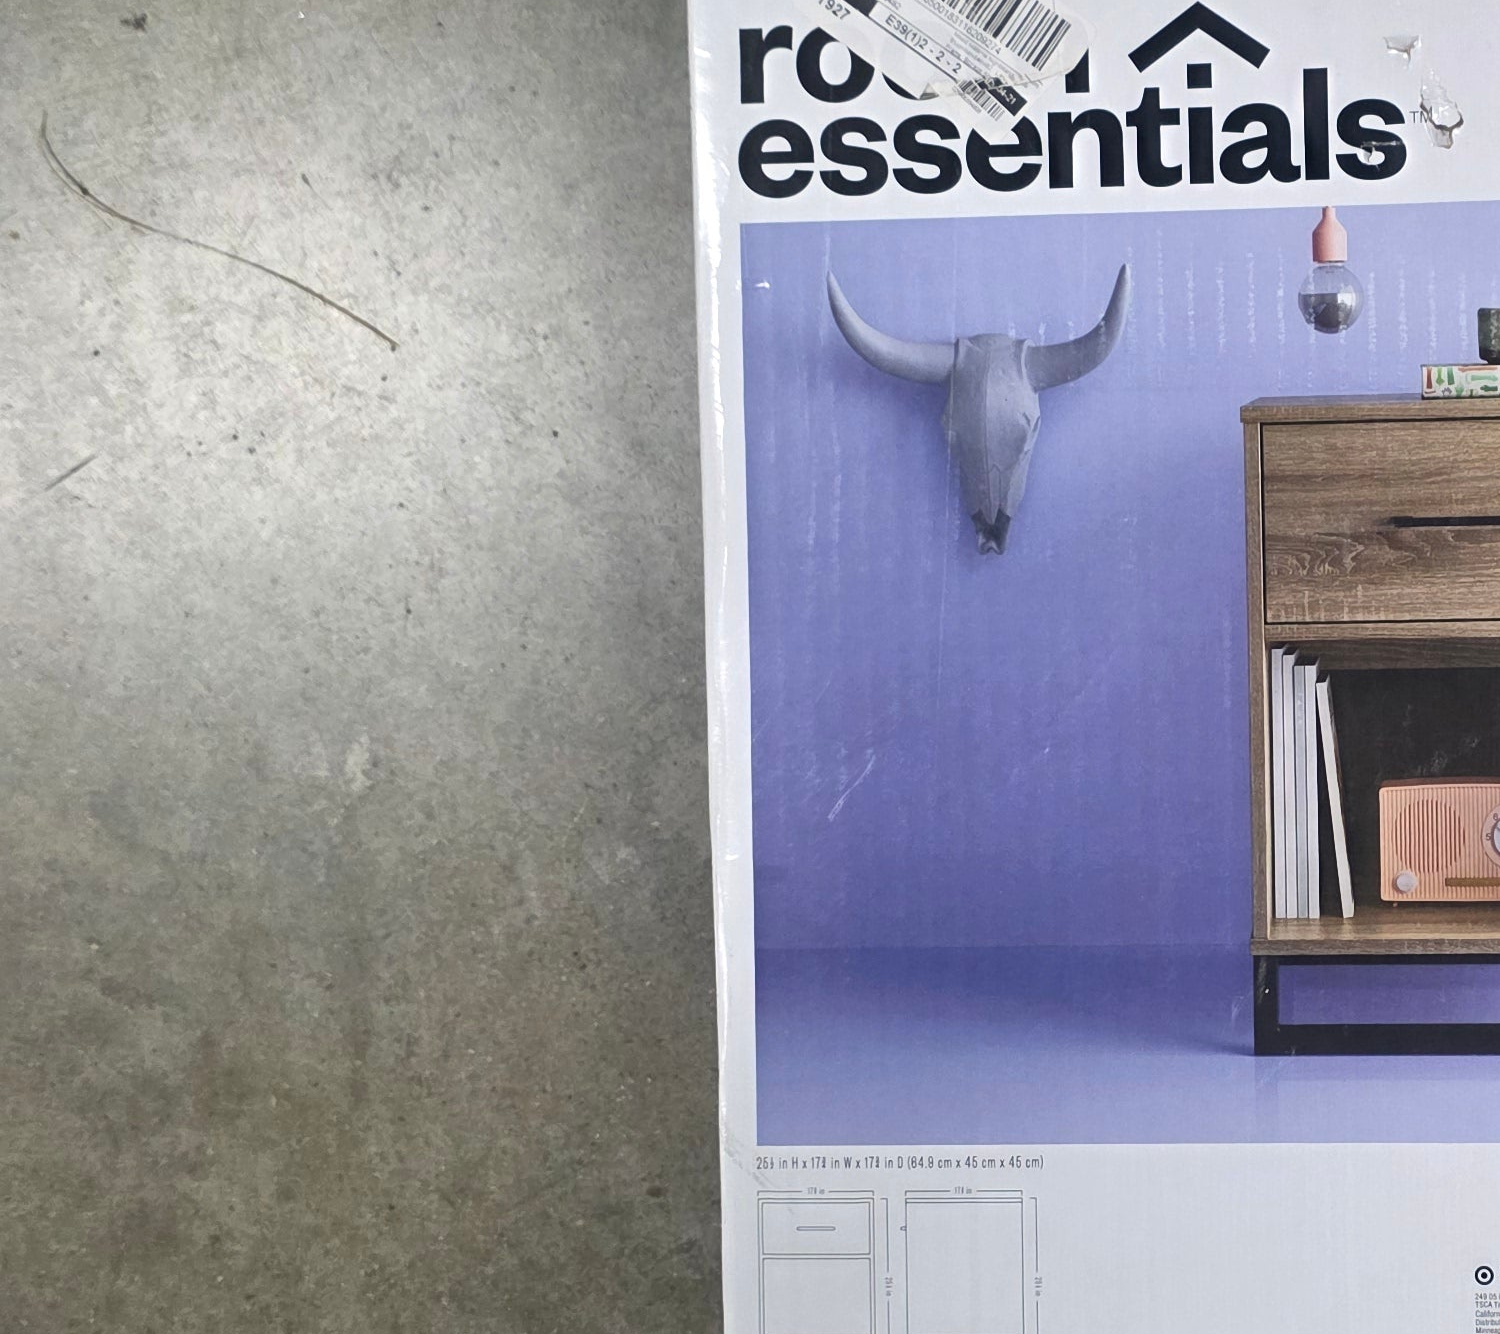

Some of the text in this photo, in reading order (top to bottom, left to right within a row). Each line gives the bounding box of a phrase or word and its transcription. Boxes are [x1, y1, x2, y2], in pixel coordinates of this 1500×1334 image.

[738, 24, 1091, 104] ro
[738, 62, 1406, 199] essentials
[779, 1156, 788, 1169] in
[791, 1156, 798, 1170] H
[831, 1156, 840, 1169] in
[843, 1156, 852, 1169] W
[884, 1156, 893, 1169] in
[897, 1155, 903, 1169] D
[907, 1155, 934, 1170] (64.9
[938, 1158, 952, 1169] cm
[965, 1155, 978, 1169] 45
[981, 1158, 996, 1169] cm
[1008, 1155, 1021, 1169] 45
[1025, 1154, 1044, 1170] cm)
[1475, 1301, 1492, 1309] TSCA
